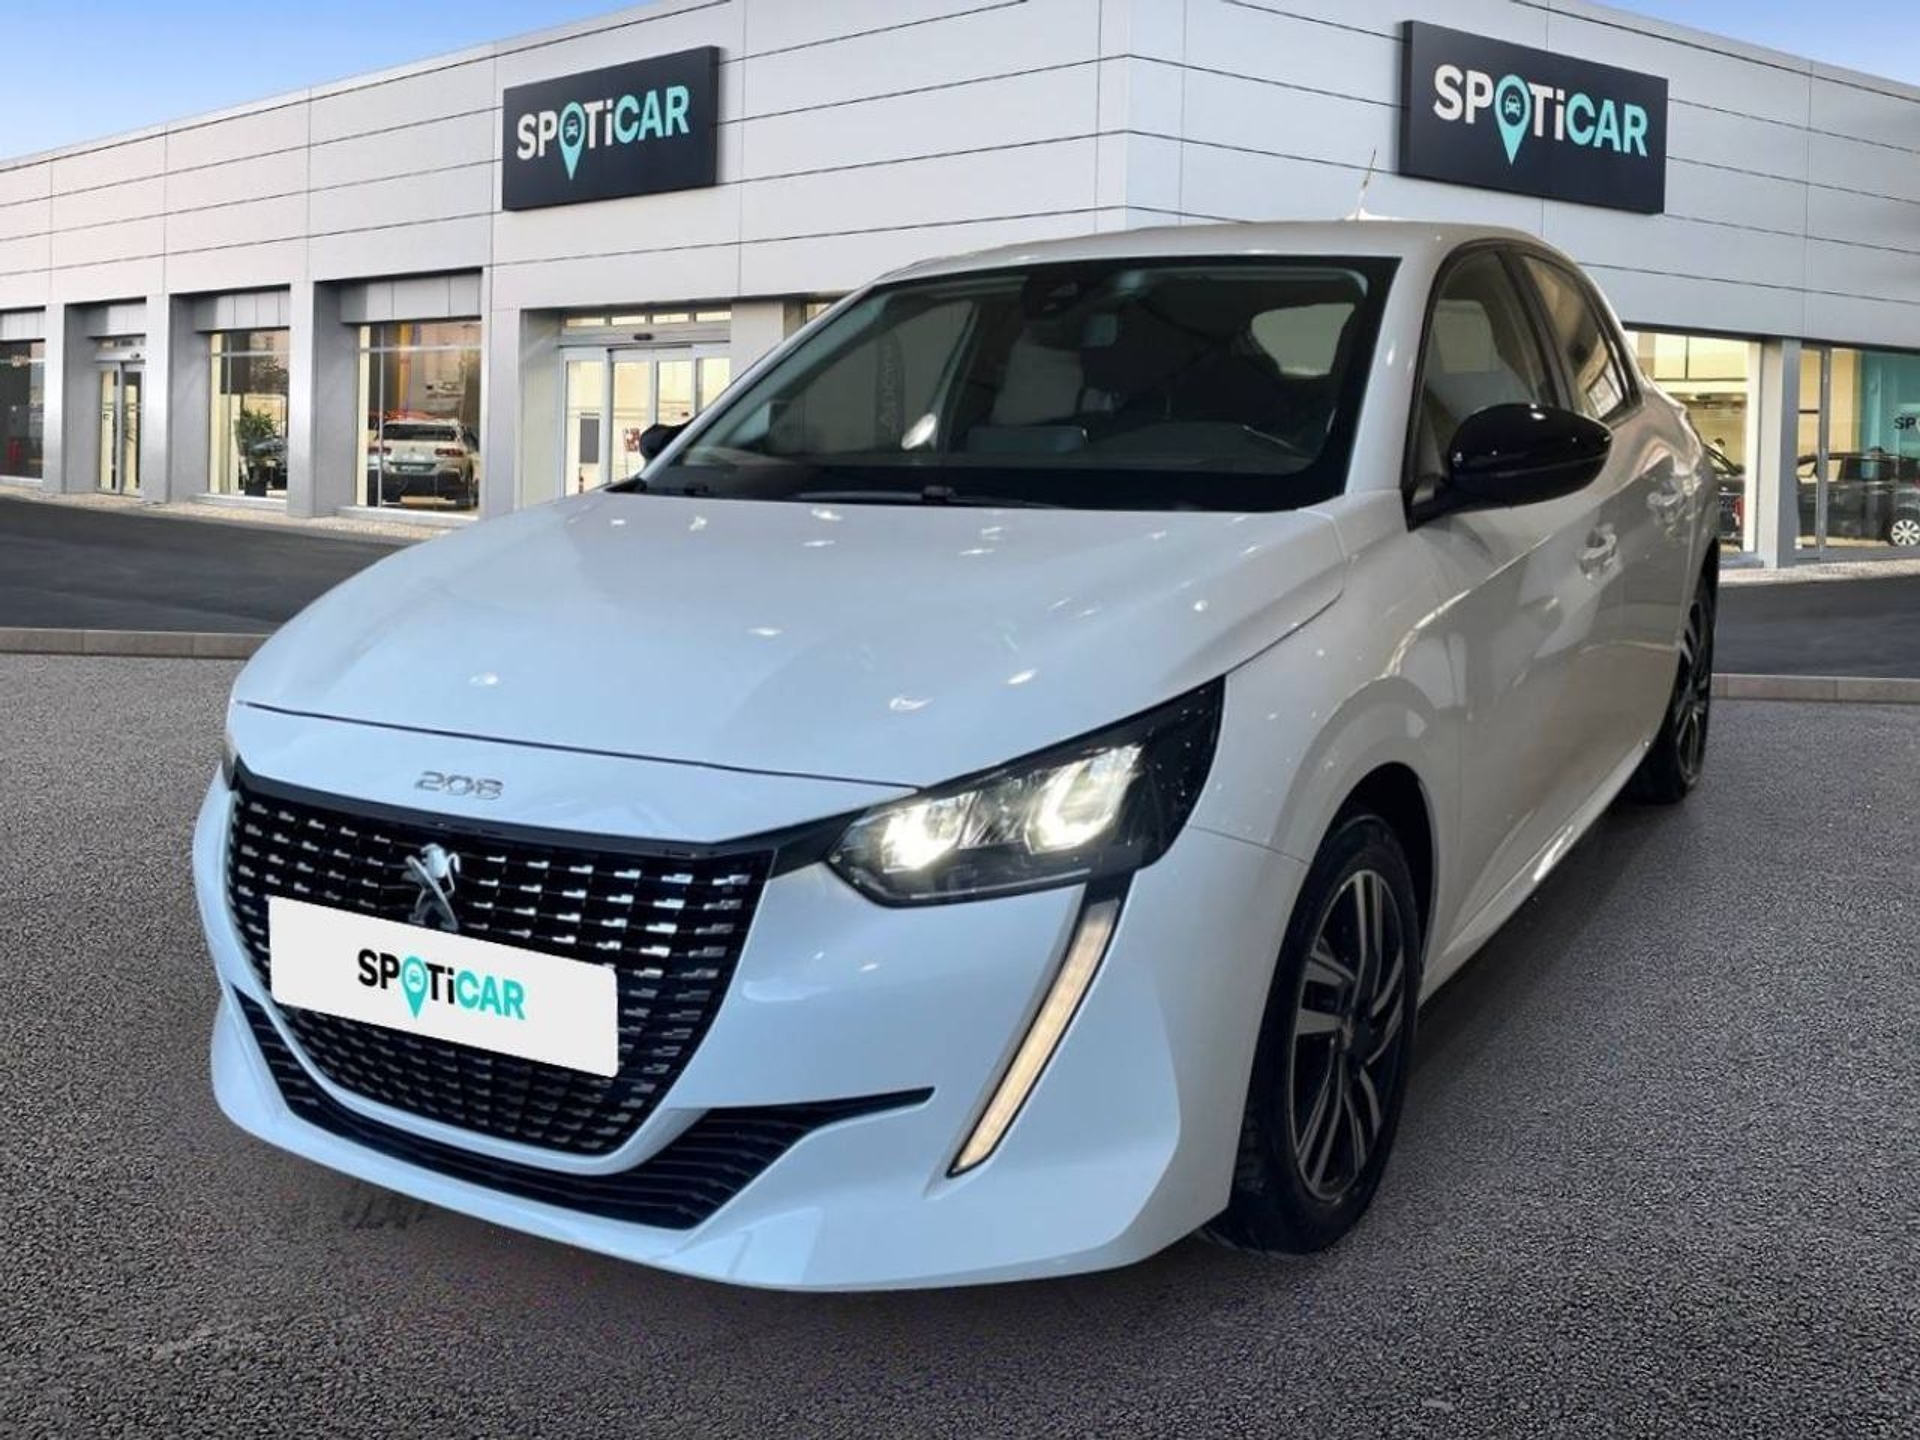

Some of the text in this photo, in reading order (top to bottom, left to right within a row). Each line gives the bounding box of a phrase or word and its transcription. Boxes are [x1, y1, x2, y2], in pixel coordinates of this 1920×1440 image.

[516, 85, 690, 181] SPOTiCAR
[1433, 64, 1648, 166] SPOTiCAR
[1894, 415, 1920, 432] SP
[414, 771, 504, 801] 208
[357, 948, 526, 1021] SPOTiCAR
